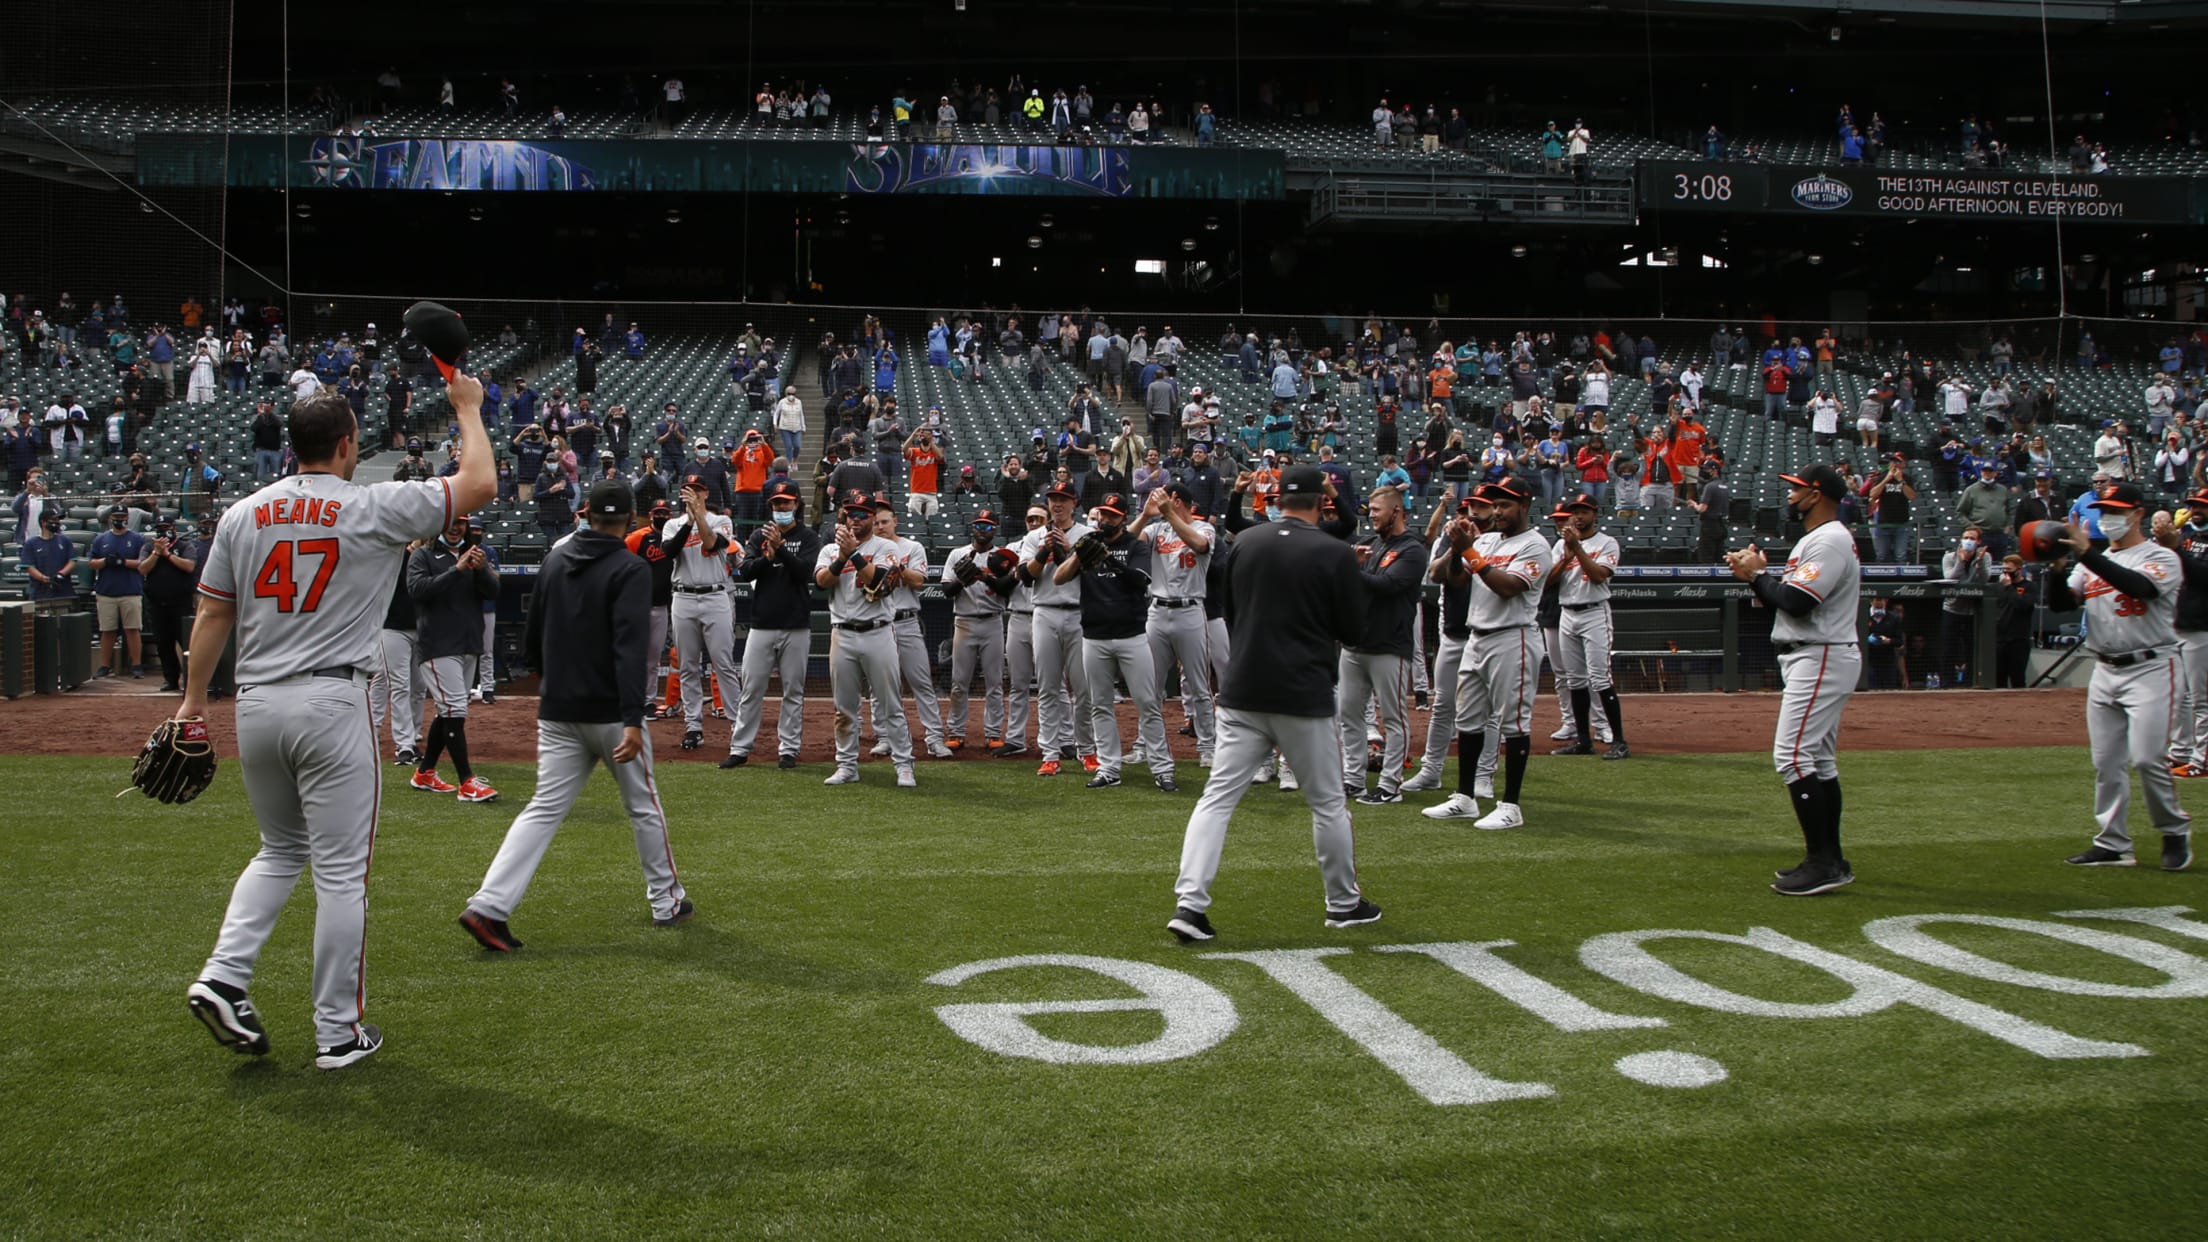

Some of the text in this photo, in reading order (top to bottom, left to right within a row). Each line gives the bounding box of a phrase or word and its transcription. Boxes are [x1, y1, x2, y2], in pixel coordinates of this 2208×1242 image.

[1674, 173, 1732, 200] 3:08
[1797, 182, 1849, 199] MARINERS
[1945, 179, 2010, 195] AGAINST
[1878, 196, 1925, 212] GOOD
[2028, 201, 2123, 217] EVERYBODY!
[255, 498, 342, 529] MEANS
[254, 537, 340, 613] 47
[918, 586, 946, 598] Alas
[1611, 588, 1657, 598] #iFlyAlaska
[1673, 585, 1708, 598] Alaska
[1723, 588, 1755, 598] #iFlyAla
[1893, 585, 1926, 597] Alaska
